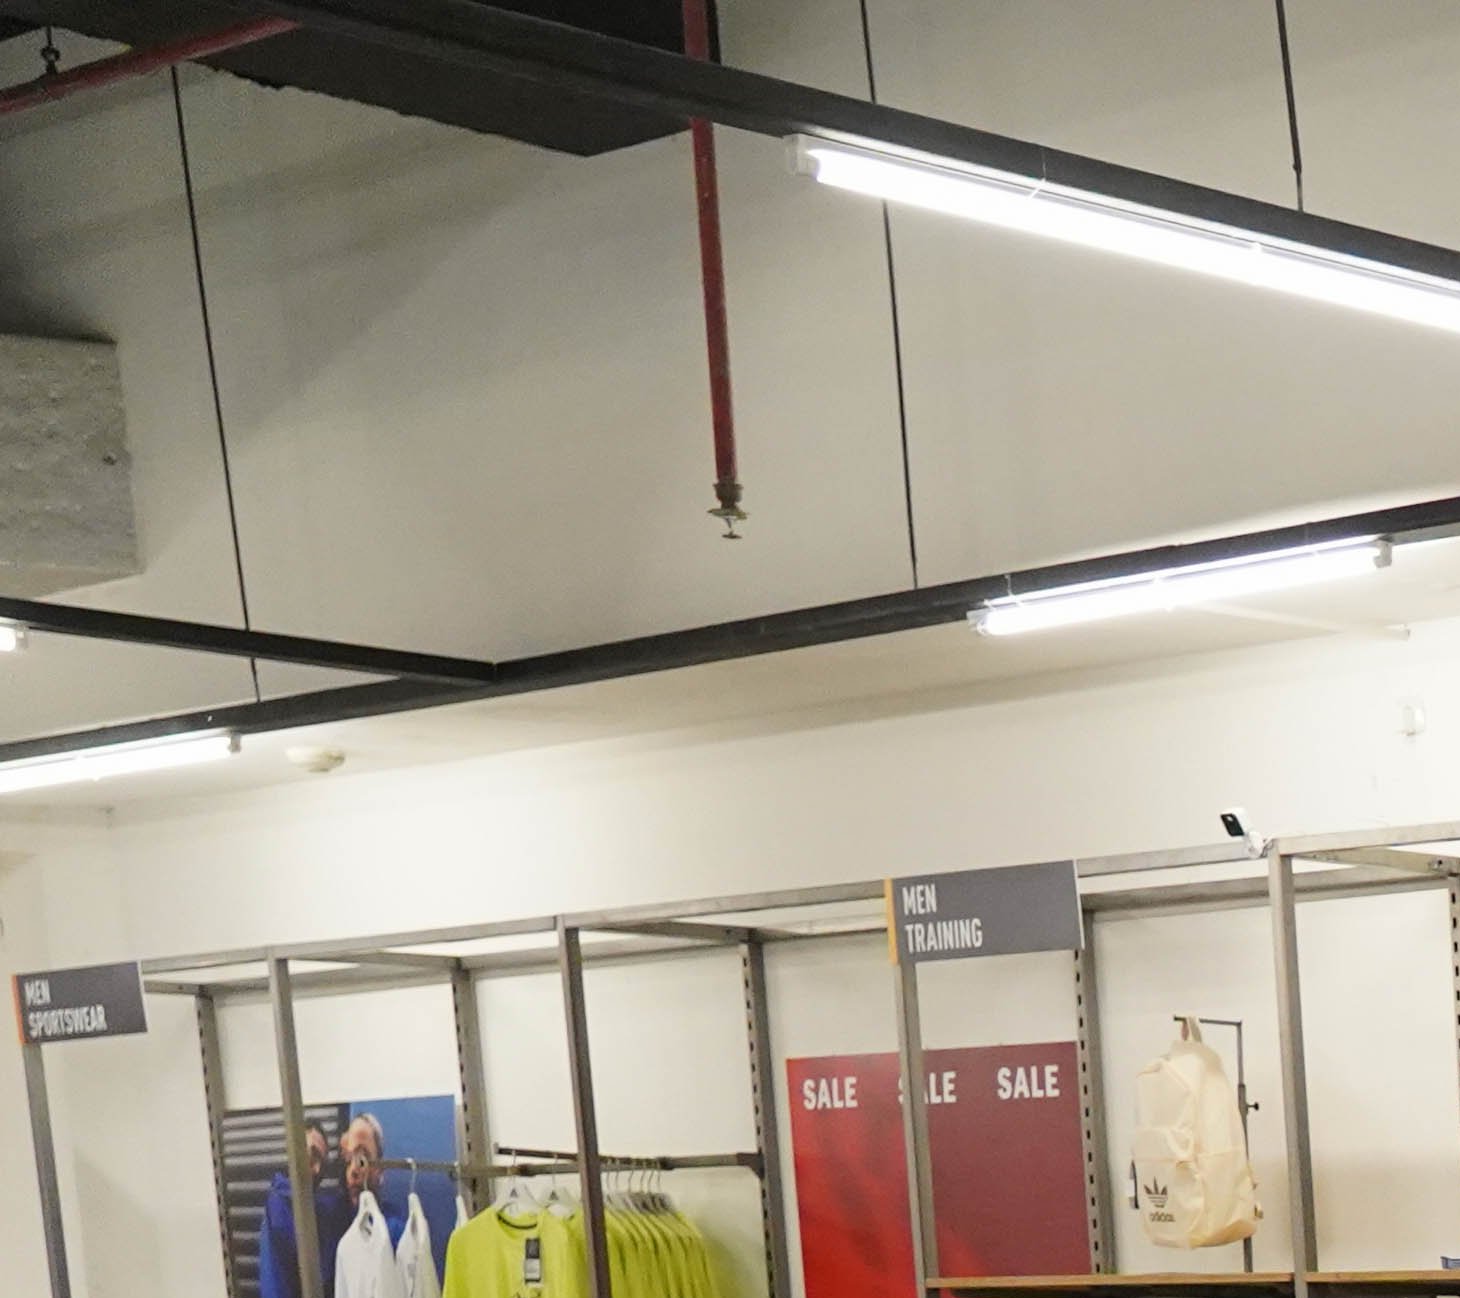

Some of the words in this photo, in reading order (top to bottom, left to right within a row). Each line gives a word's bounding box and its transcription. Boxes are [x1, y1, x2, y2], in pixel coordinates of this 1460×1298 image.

[902, 883, 937, 916] MEN
[904, 918, 983, 954] TRAINING
[803, 1076, 858, 1110] SALE
[898, 1071, 957, 1104] LE
[997, 1064, 1060, 1100] SALE
